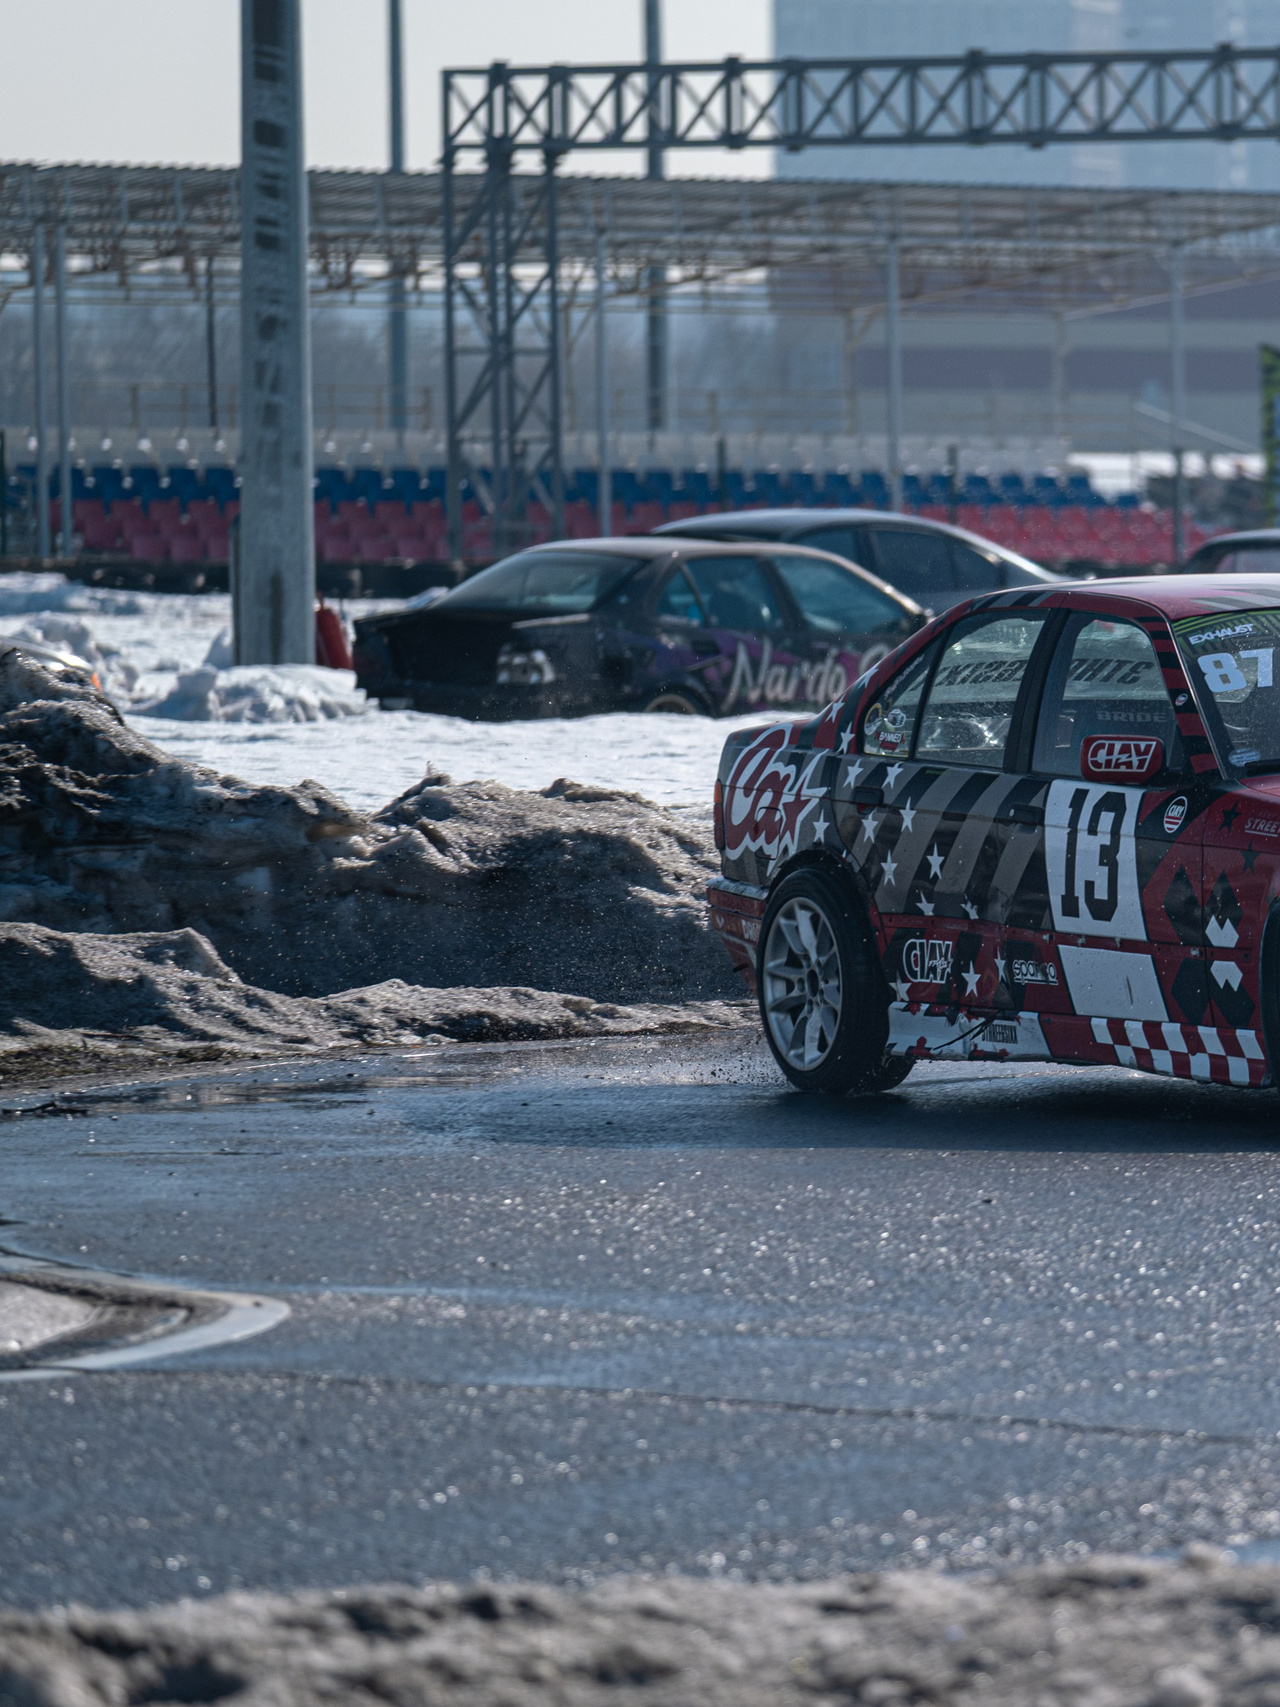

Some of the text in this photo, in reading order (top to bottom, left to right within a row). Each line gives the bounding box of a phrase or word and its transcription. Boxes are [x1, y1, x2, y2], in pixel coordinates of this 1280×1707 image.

[1188, 623, 1254, 645] EXHAUST
[721, 637, 848, 713] Nardo
[1197, 647, 1276, 693] 87
[1096, 710, 1168, 723] BRIDE
[879, 731, 902, 743] BANNED
[1062, 787, 1130, 921] 13
[1012, 959, 1058, 985] sparo
